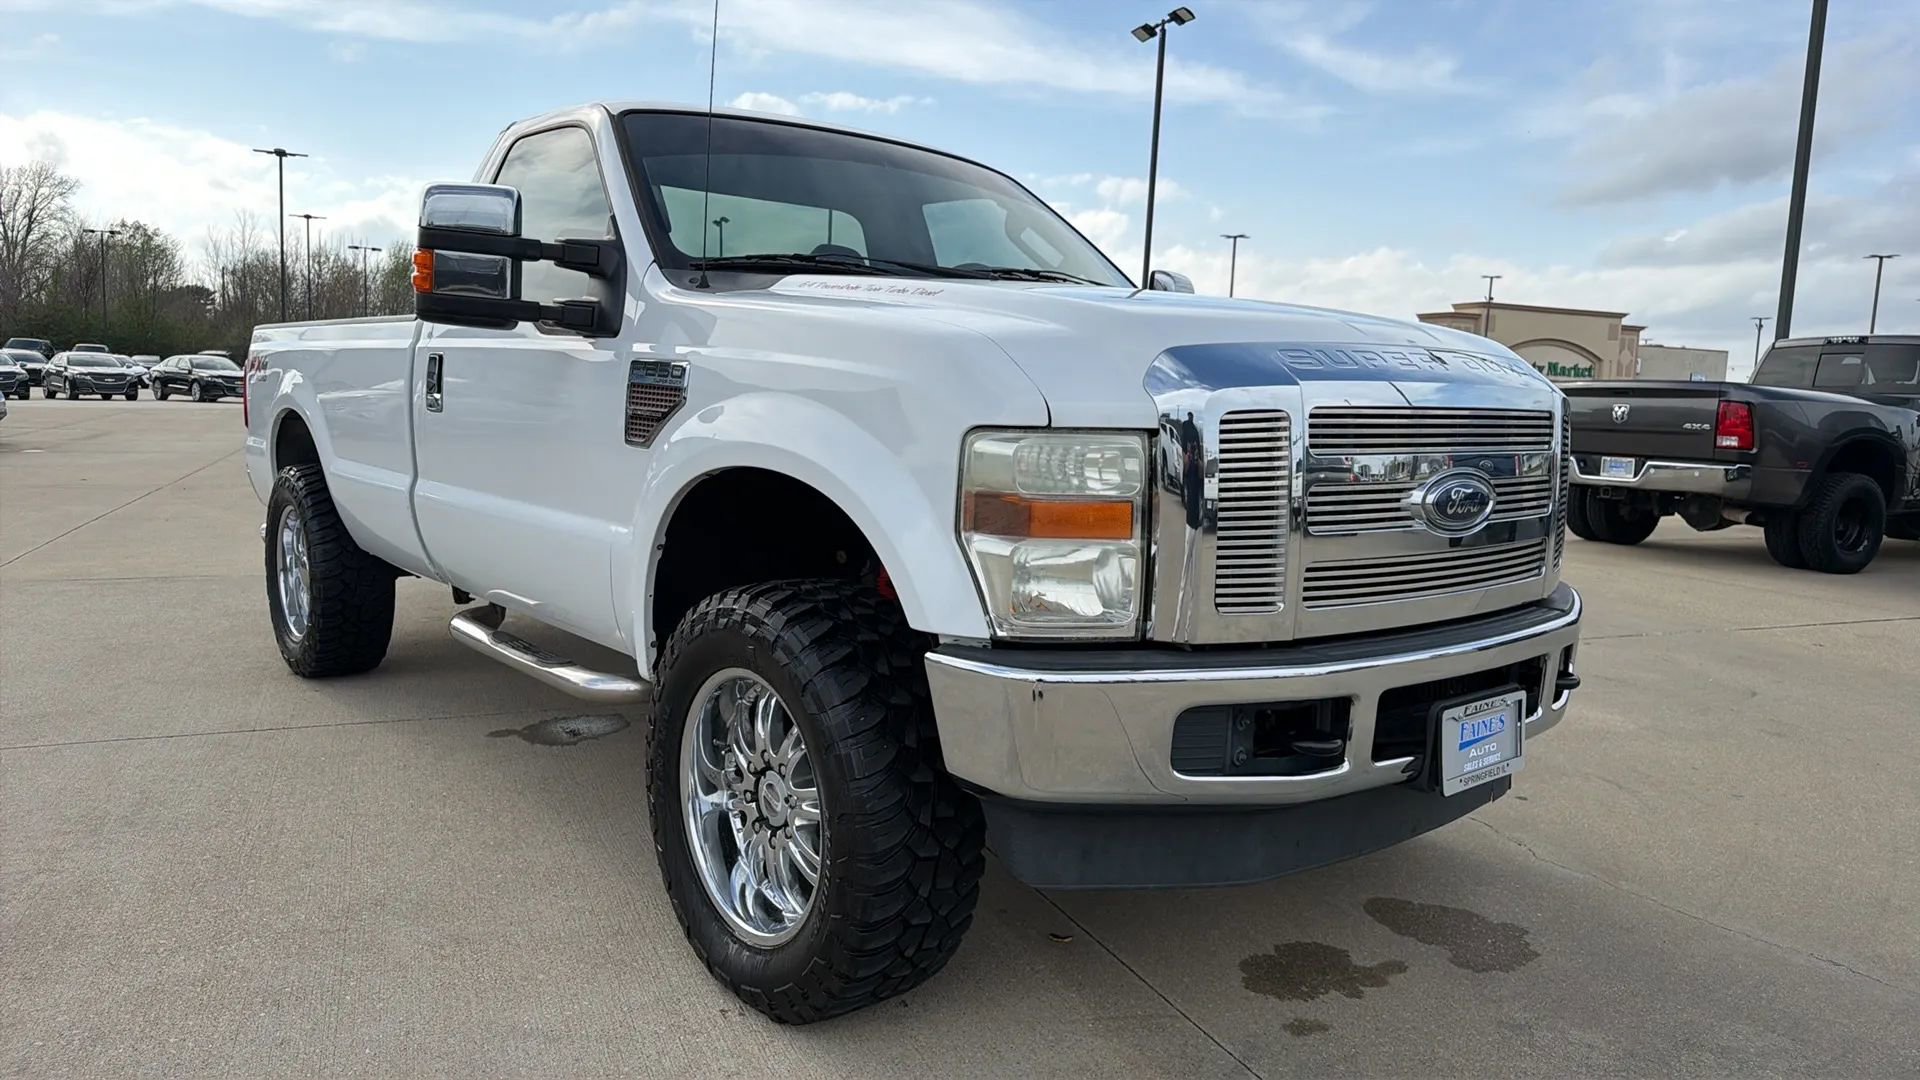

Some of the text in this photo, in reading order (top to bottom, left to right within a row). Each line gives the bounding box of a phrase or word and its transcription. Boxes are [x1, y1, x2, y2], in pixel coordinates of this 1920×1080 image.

[1276, 348, 1448, 371] SUPER
[1547, 361, 1594, 378] Market
[1446, 487, 1480, 515] Ford
[1463, 696, 1507, 715] FAINE'S
[1460, 713, 1505, 742] FAINE'S
[1469, 742, 1497, 758] AUTO
[1463, 766, 1501, 787] SPRINGFIELD
